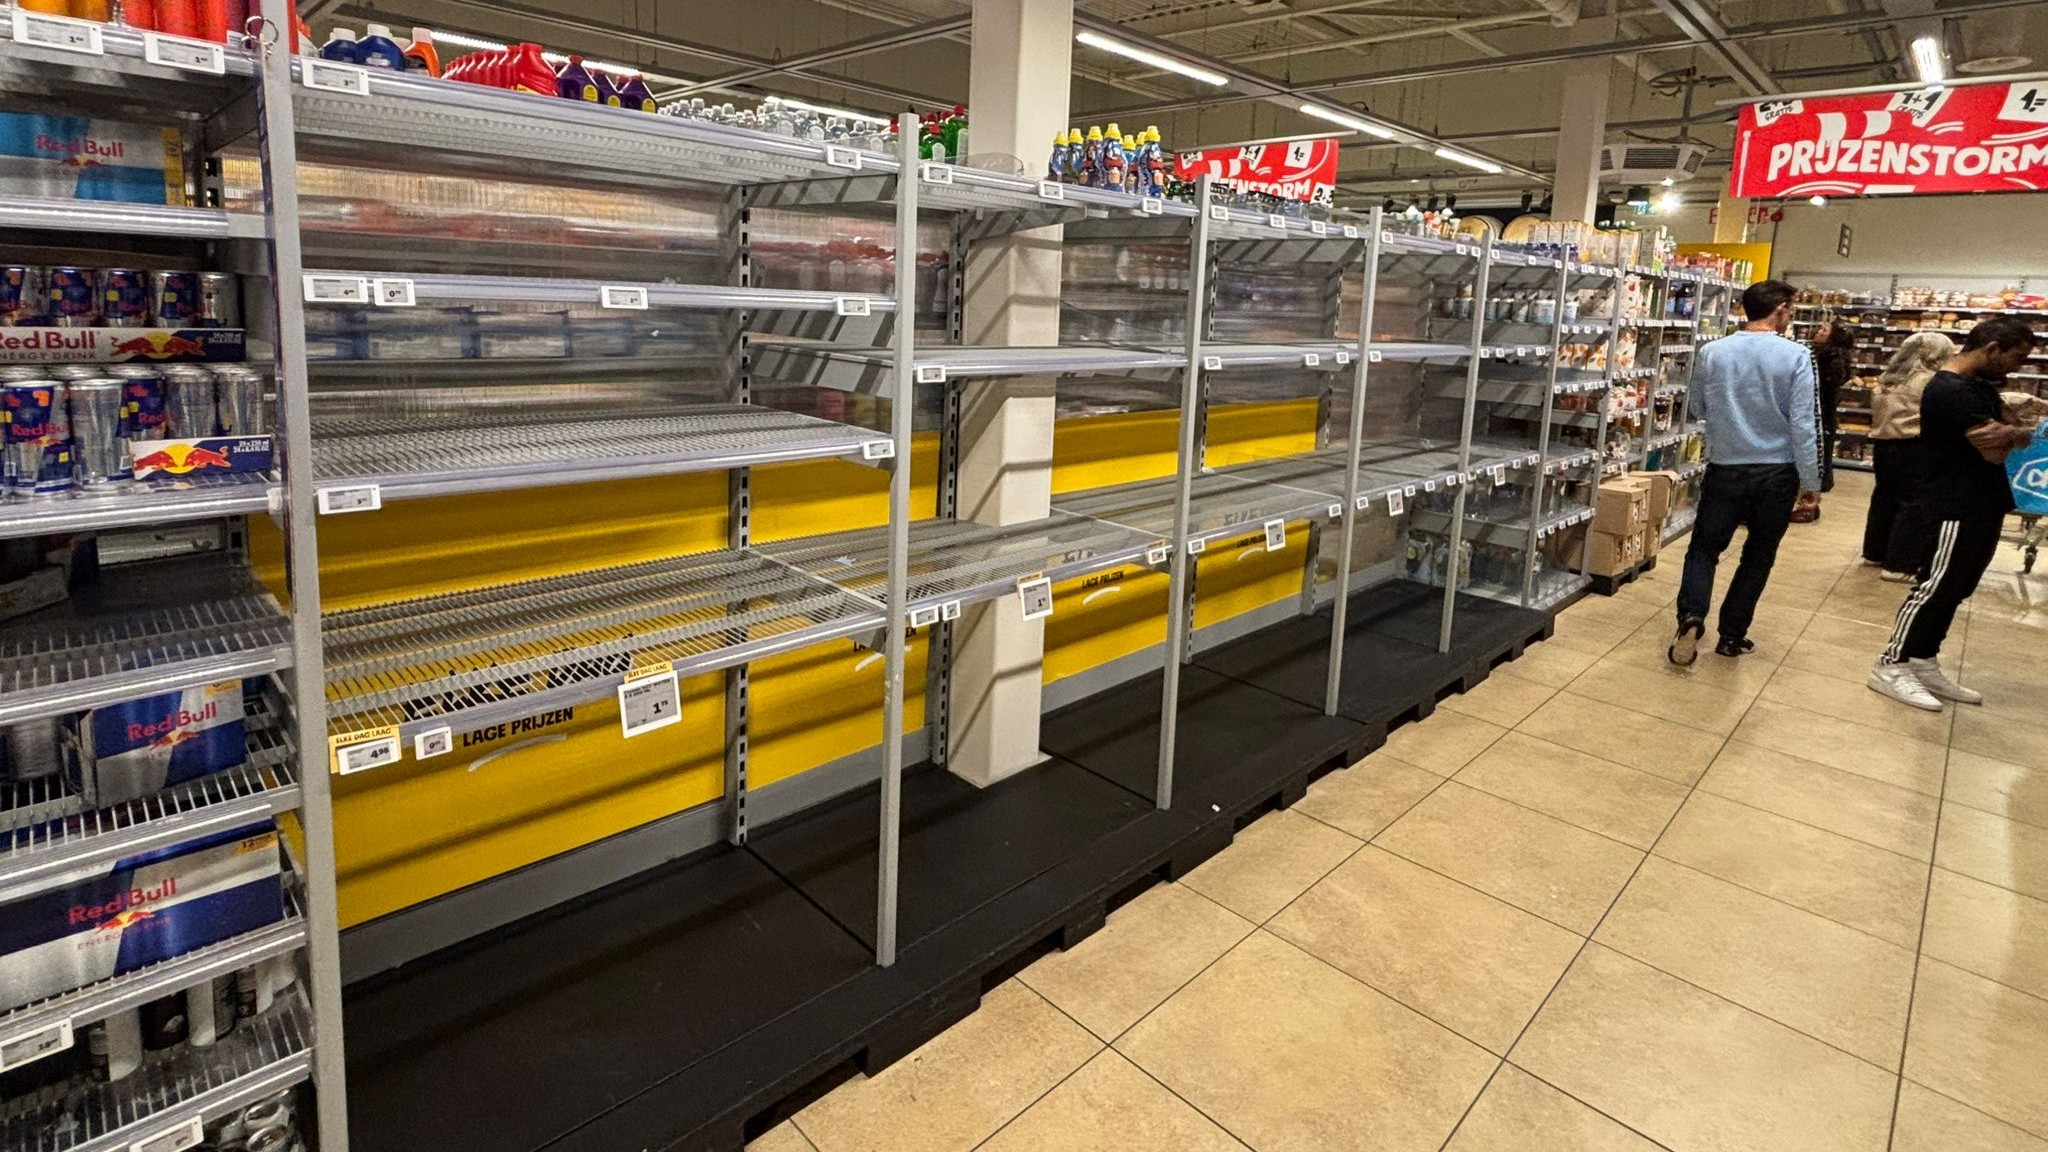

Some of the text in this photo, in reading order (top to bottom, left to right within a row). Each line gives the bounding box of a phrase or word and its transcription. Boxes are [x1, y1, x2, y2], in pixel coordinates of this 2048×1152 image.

[1764, 105, 1793, 121] GRATIS
[36, 134, 124, 158] Red Bull
[1767, 139, 2048, 182] PRIJZENSTORM
[45, 331, 96, 349] Bull
[0, 352, 46, 360] NERGY
[127, 701, 217, 741] Red Bull
[463, 724, 506, 748] LAGE
[511, 707, 573, 735] PRIJZEN
[354, 732, 371, 740] DAG
[372, 728, 391, 737] LAAG
[68, 877, 177, 926] Red Bull
